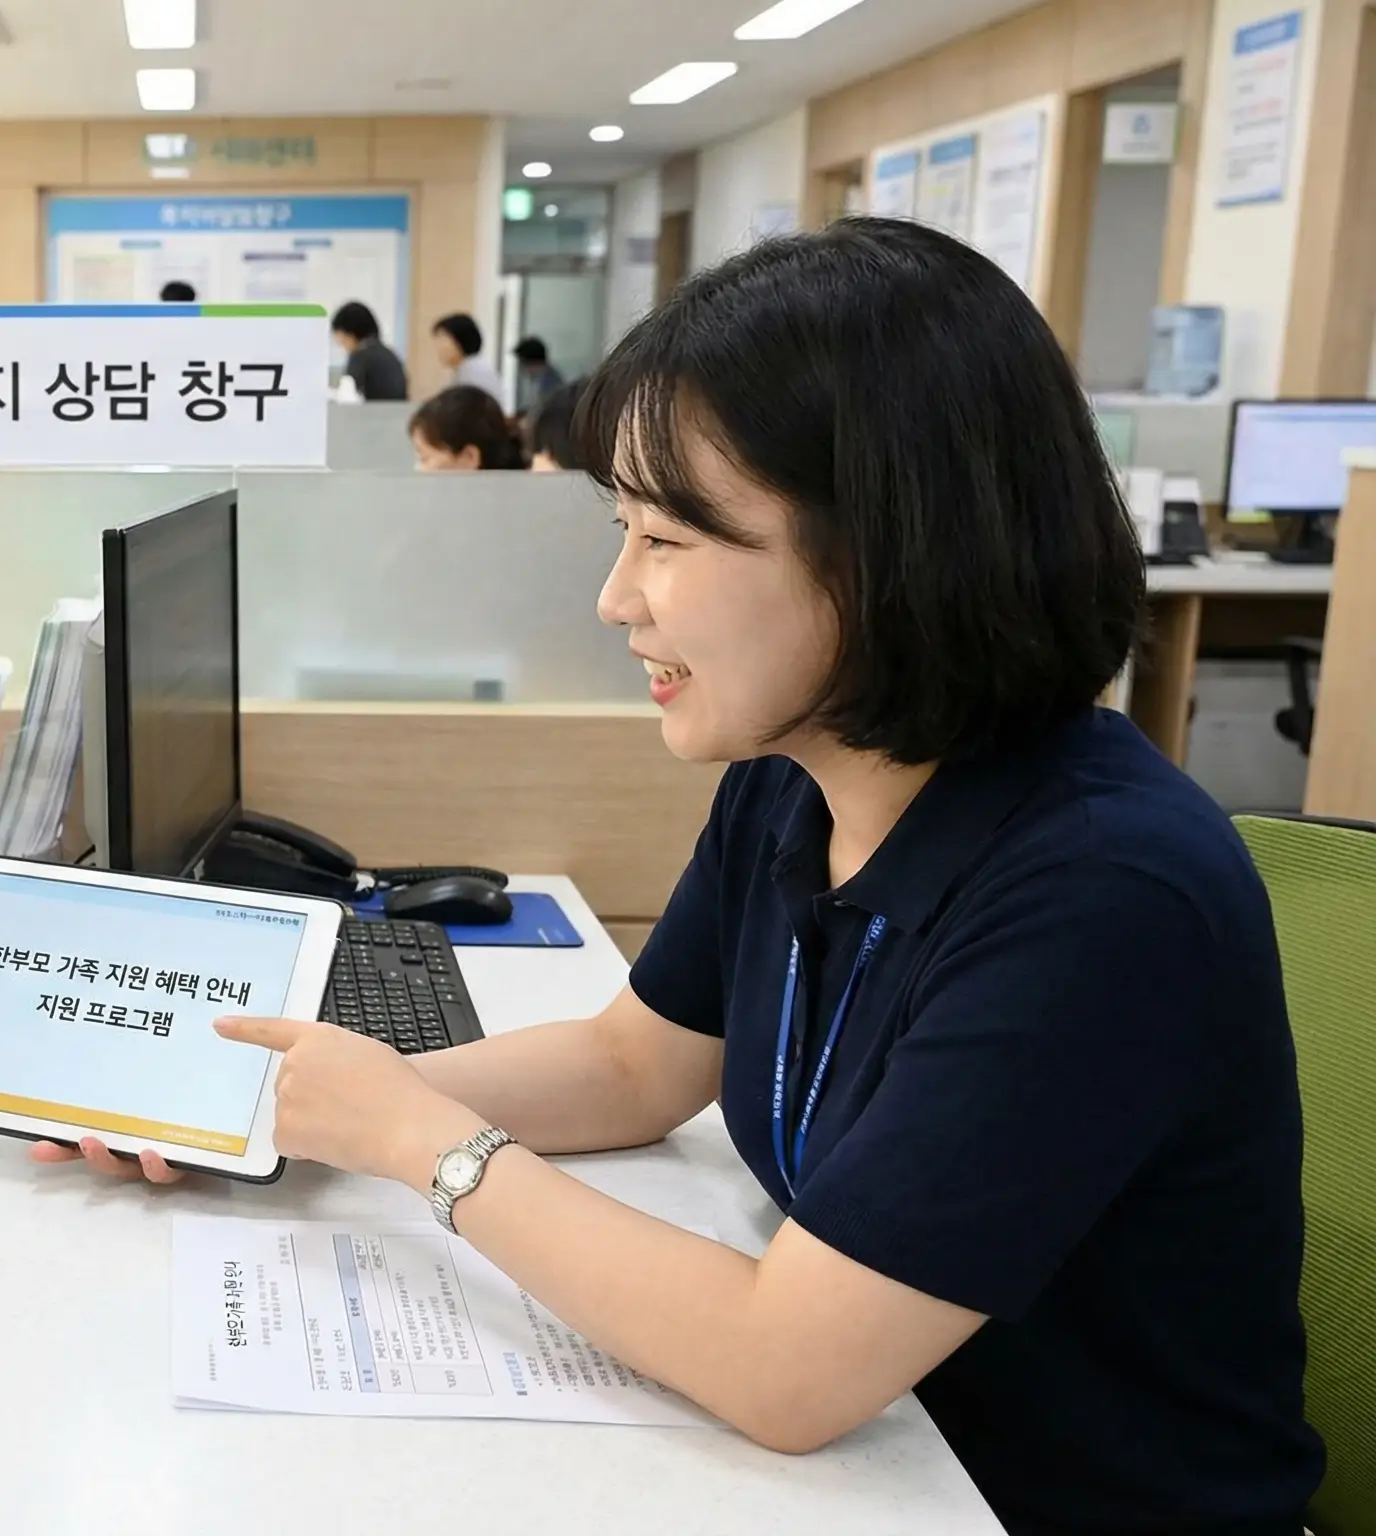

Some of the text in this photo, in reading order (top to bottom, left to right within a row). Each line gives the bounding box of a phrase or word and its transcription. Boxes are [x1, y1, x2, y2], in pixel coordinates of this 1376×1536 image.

[45, 360, 157, 422] 상담
[177, 360, 290, 422] 창구
[56, 955, 101, 984] 가족
[105, 962, 149, 992] 지원
[154, 969, 201, 1000] 혜택
[206, 977, 252, 1007] 안내
[36, 993, 176, 1038] 지원 프로그램
